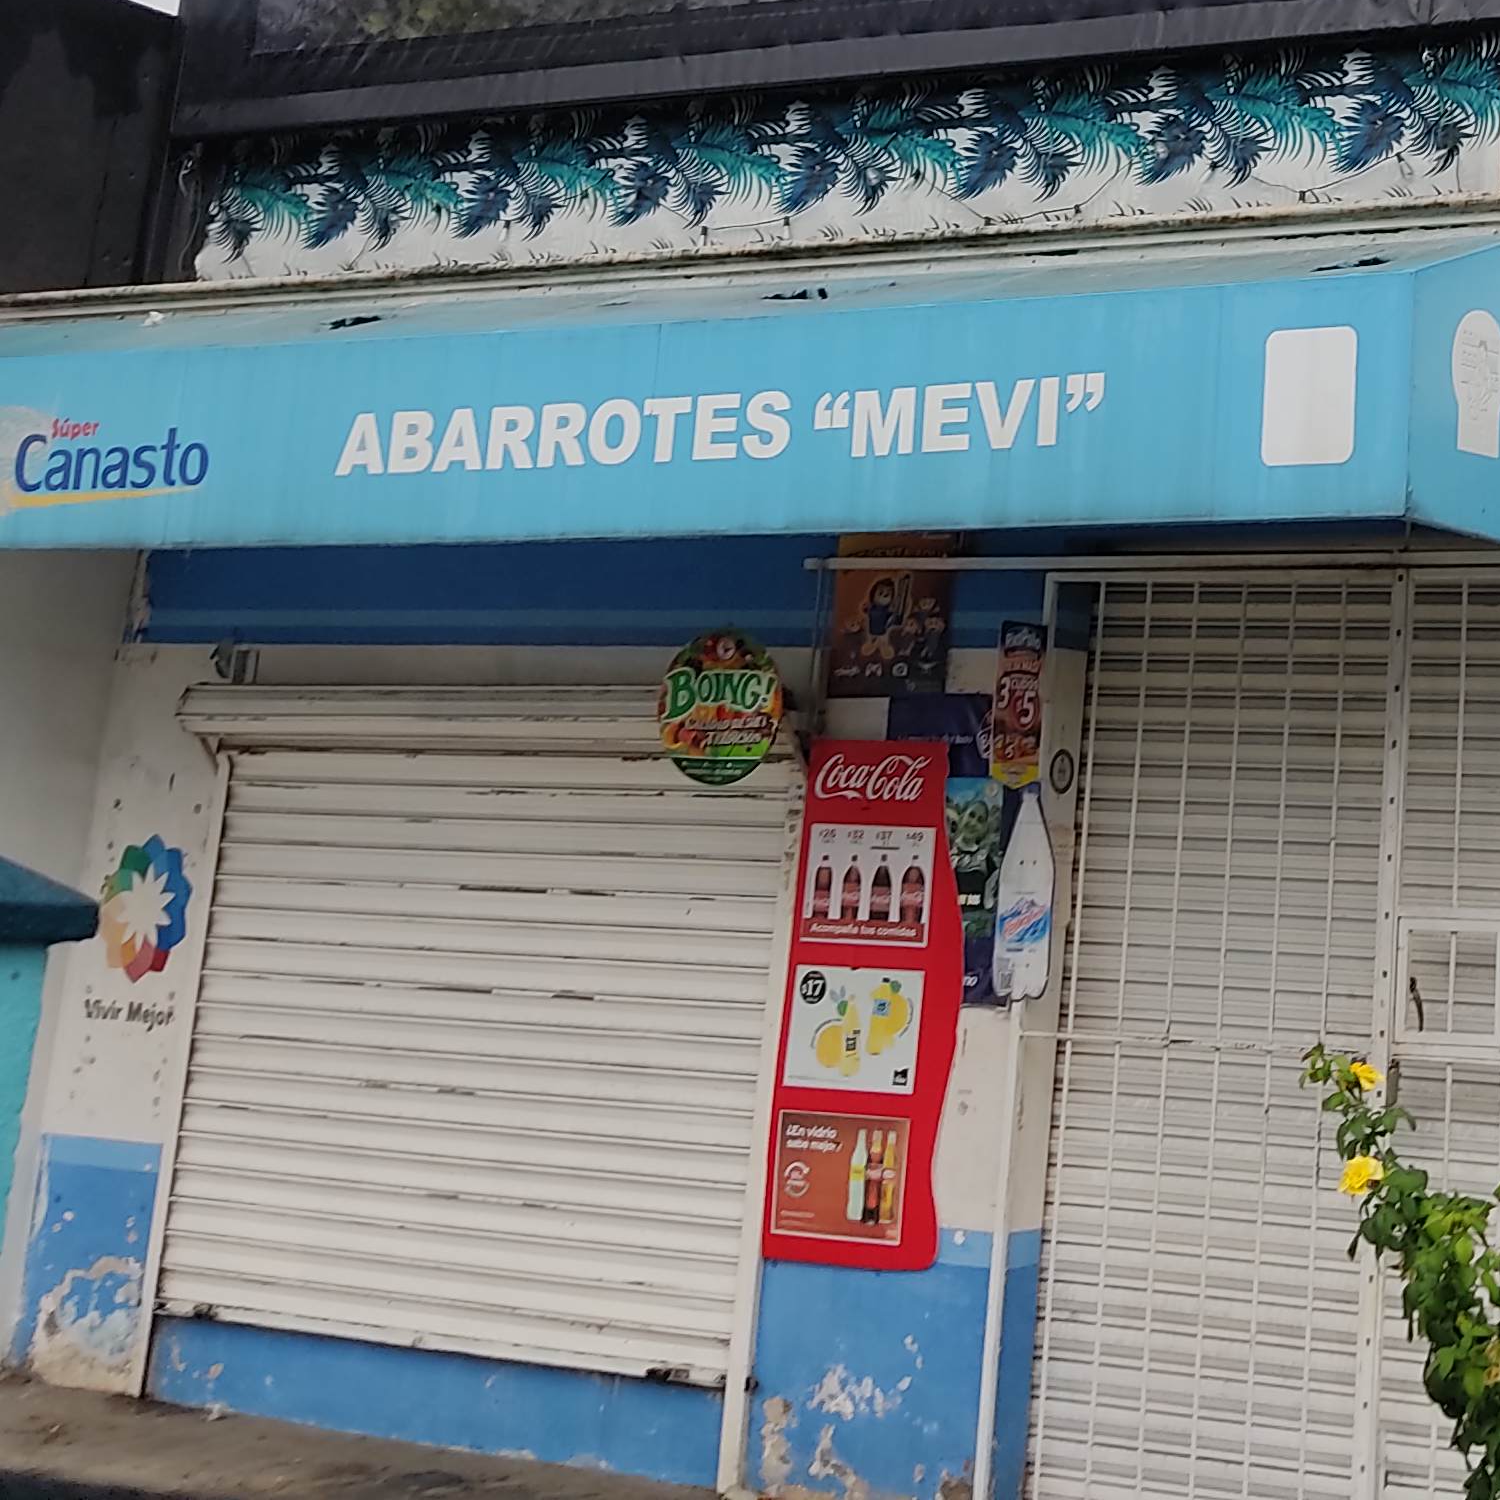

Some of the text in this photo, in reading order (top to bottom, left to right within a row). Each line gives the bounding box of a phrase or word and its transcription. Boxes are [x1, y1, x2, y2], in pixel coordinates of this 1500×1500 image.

[51, 418, 99, 440] Súper
[334, 391, 792, 476] ABARROTES
[15, 427, 209, 492] Canasto
[661, 668, 778, 721] BOING!
[801, 979, 824, 996] $17
[84, 999, 123, 1020] Vivir
